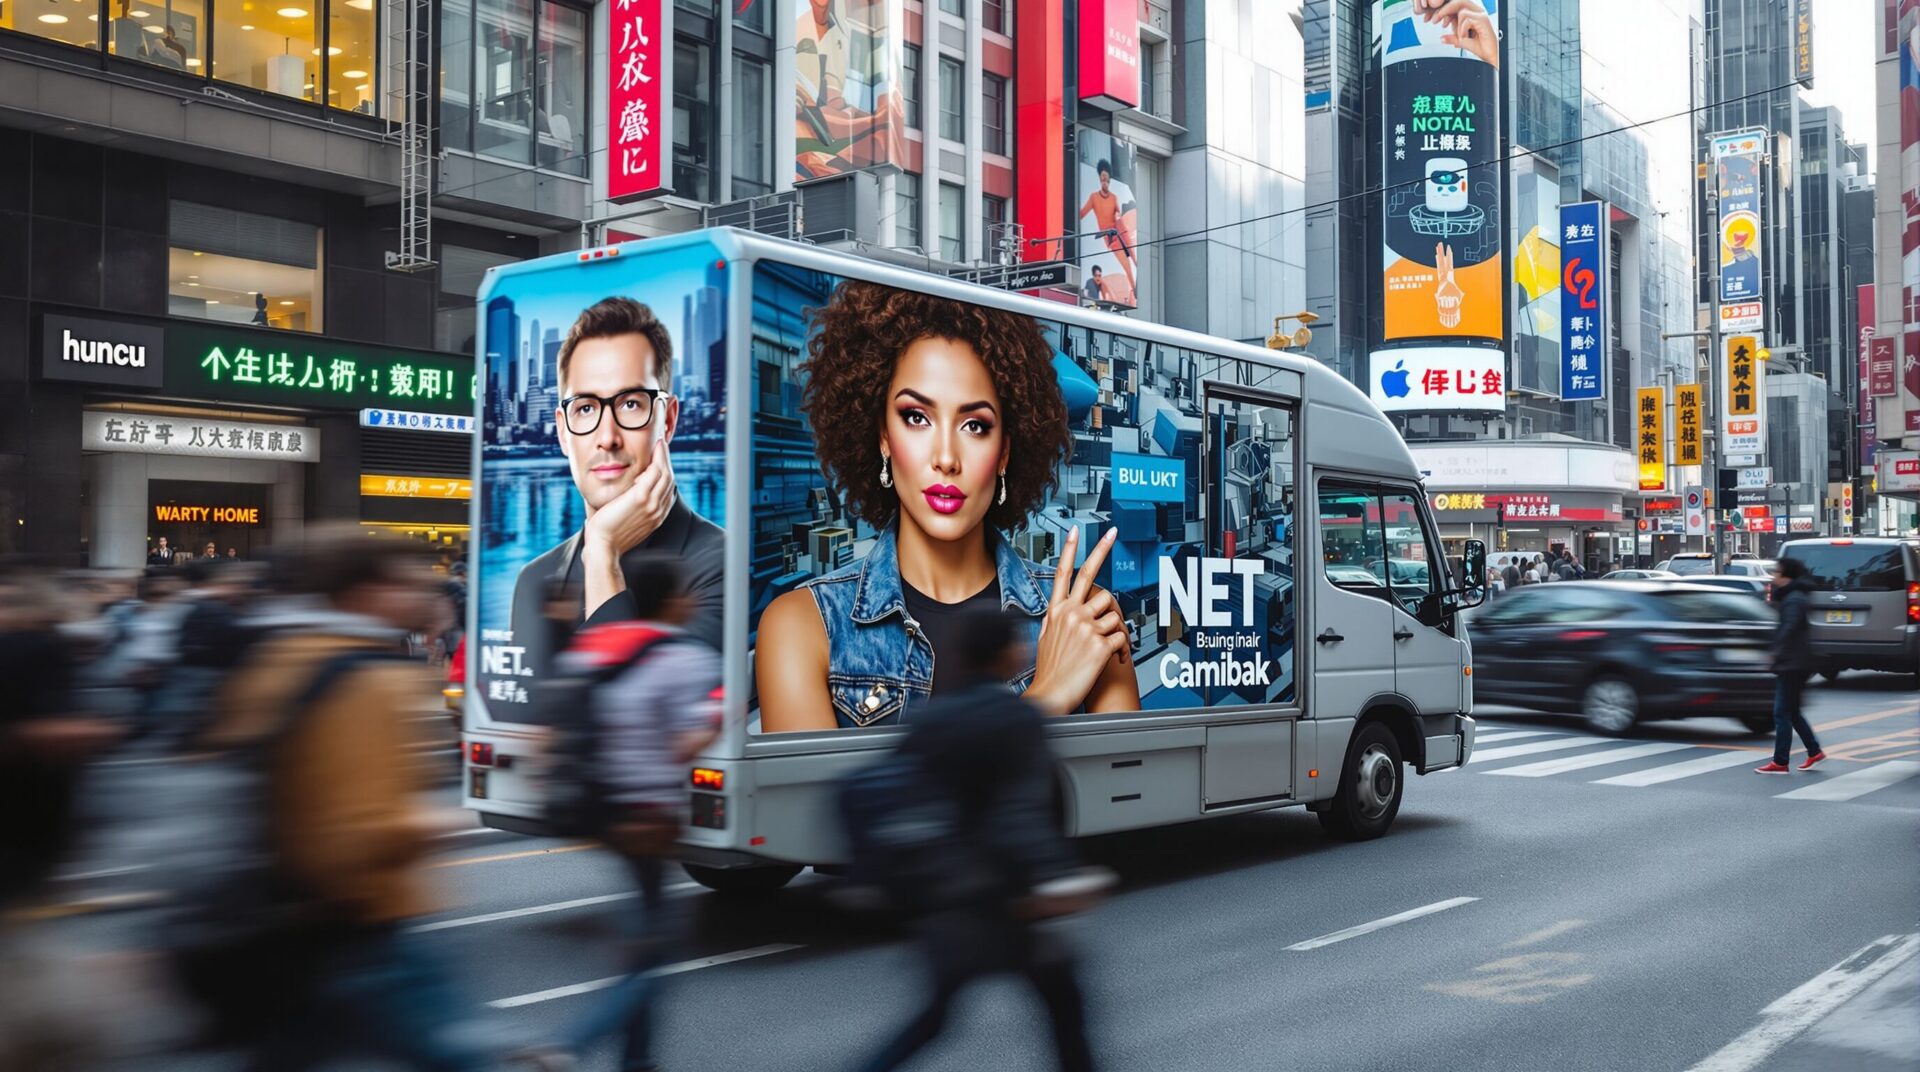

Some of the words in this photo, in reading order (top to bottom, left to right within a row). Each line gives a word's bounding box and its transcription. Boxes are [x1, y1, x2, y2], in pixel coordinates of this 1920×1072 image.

[1412, 116, 1475, 132] NOTAL
[63, 329, 146, 368] huncu
[1119, 467, 1148, 485] BUL
[1150, 471, 1178, 488] UKT
[156, 505, 210, 522] WARTY
[213, 507, 259, 523] HOME
[1158, 555, 1265, 627] NET
[1159, 651, 1271, 689] Camibak
